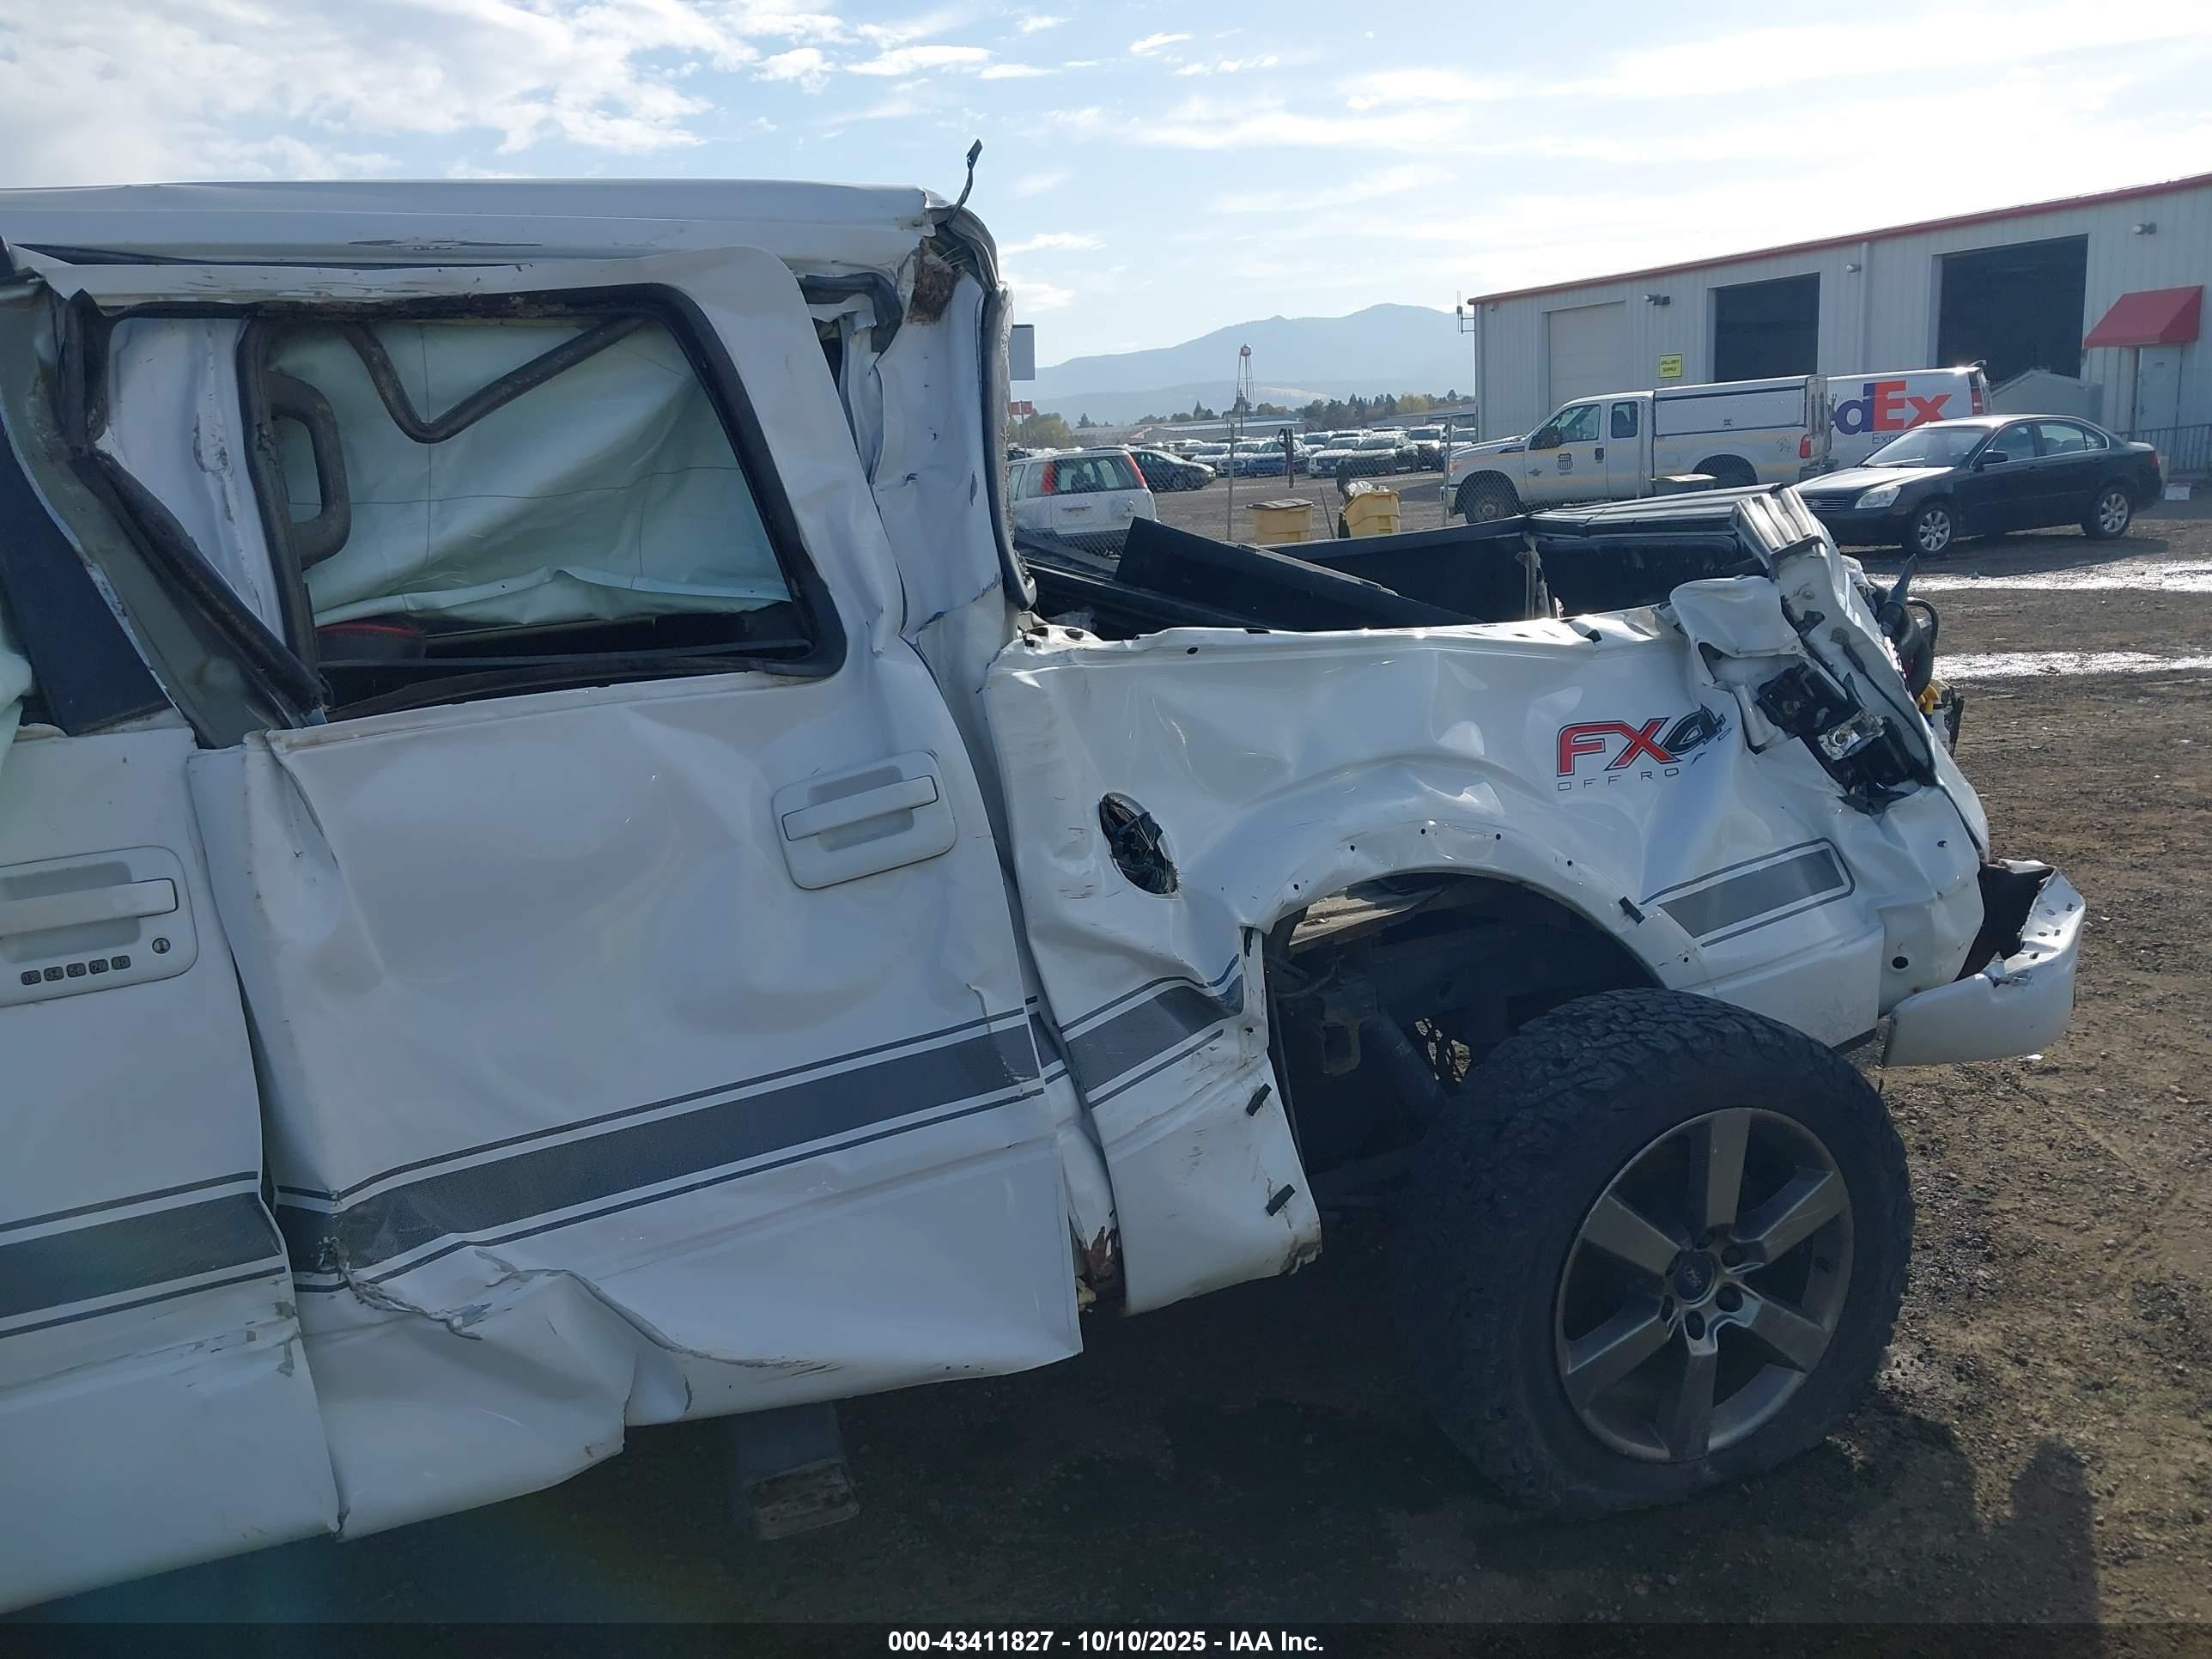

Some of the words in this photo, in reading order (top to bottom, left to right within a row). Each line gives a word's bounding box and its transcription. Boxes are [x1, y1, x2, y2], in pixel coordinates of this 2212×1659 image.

[1835, 380, 1953, 435] dEx
[1557, 703, 1732, 777] FX4
[1558, 775, 1621, 791] OFF
